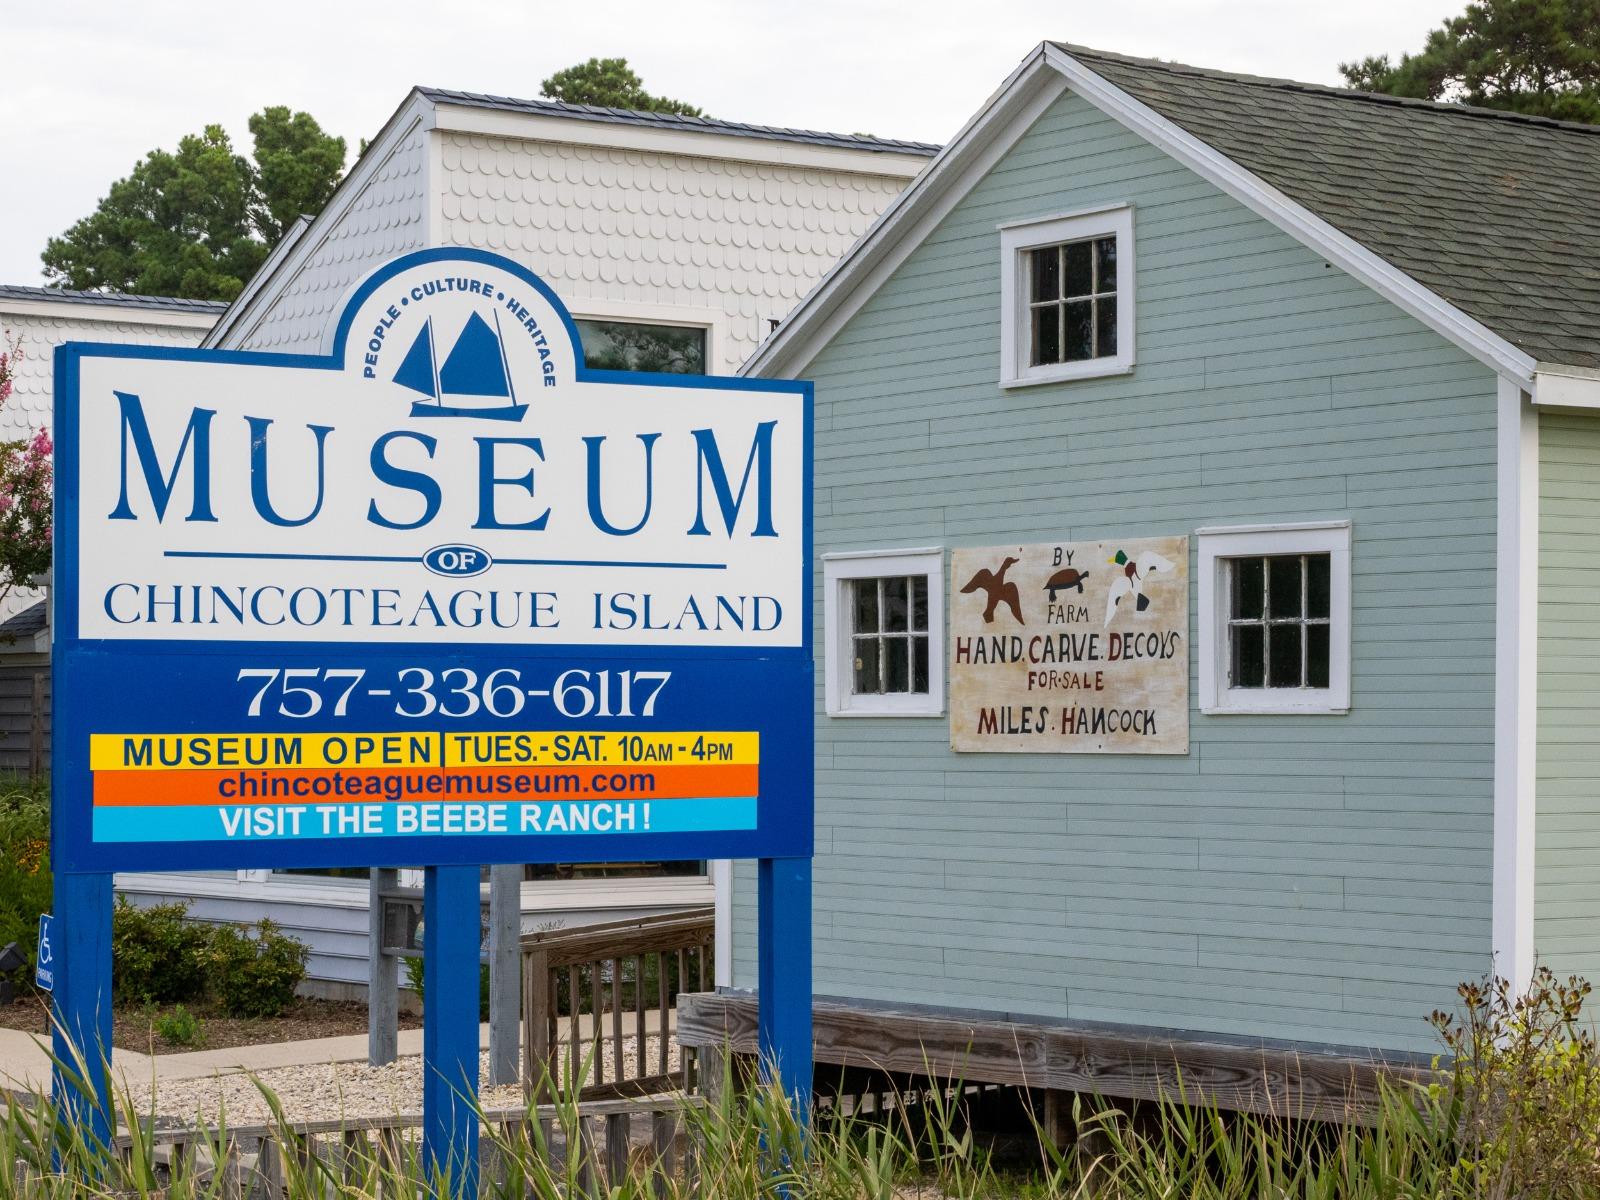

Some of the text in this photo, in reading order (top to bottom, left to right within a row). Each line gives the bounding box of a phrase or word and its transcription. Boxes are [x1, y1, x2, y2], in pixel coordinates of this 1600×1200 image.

[363, 277, 556, 387] PEOPLE CULTURE HERITAGE
[107, 391, 778, 538] MUSEUM
[436, 551, 478, 571] OF
[1051, 546, 1075, 567] BY
[104, 583, 783, 632] CHINCOTEAGUE ISLAND
[1047, 604, 1089, 625] FARM
[237, 667, 672, 718] 757-336-6117
[1060, 706, 1157, 736] HANCOCK
[123, 737, 302, 767] MUSEUM
[322, 737, 431, 765] OPEN
[218, 770, 655, 801] chincoteaguemuseum.com
[218, 802, 652, 838] VISIT THE BEEBE RANCH!
